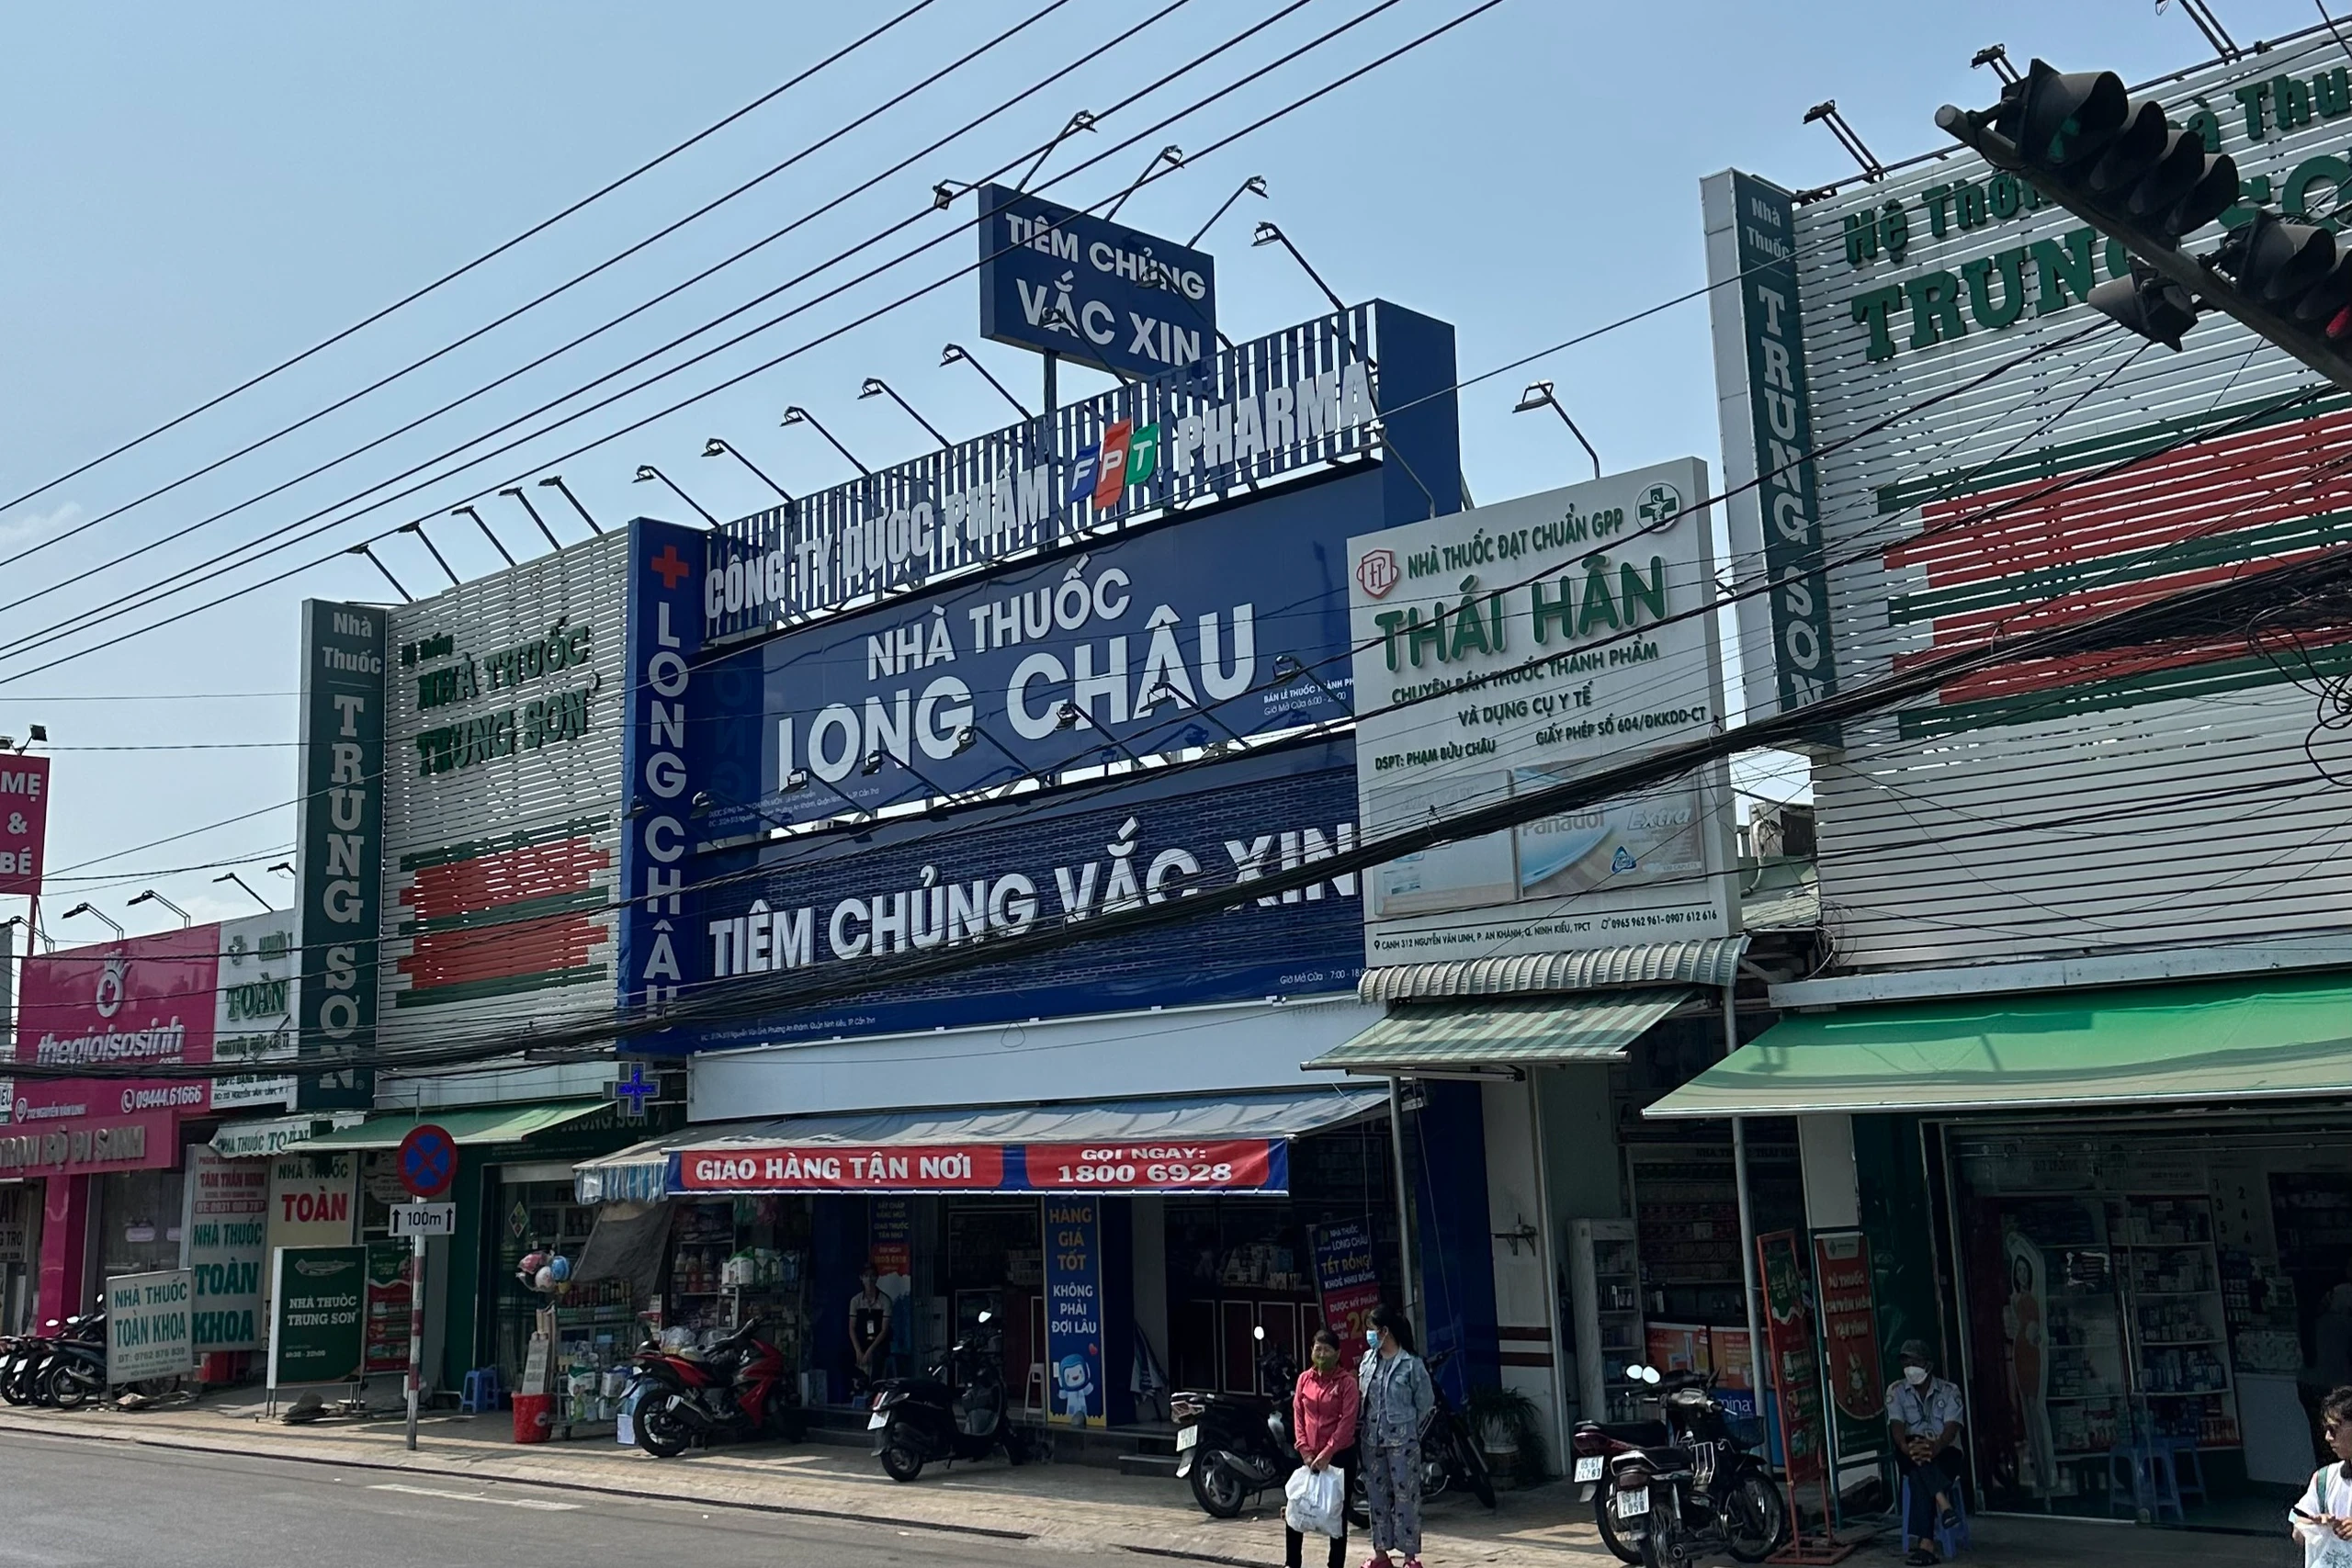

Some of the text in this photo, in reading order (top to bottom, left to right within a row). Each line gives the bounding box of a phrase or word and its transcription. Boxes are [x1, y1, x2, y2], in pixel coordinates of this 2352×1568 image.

[1751, 197, 1781, 229] Nhà
[1747, 225, 1791, 263] Thuốc
[1844, 197, 1908, 265] Hệ
[1005, 212, 1206, 300] TIÊM CHỦNG
[1850, 226, 2141, 364] TRUN
[1015, 269, 1201, 367] VẮC XIN
[1757, 283, 1808, 547] TRUNG
[705, 551, 786, 619] CÔNG
[795, 533, 834, 593] TY
[842, 502, 933, 581] DƯỢC
[945, 457, 1049, 549] PHẨM
[1178, 360, 1373, 477] PHARMA
[1408, 544, 1438, 580] NHÀ
[1443, 525, 1494, 571] THUỐC
[1498, 529, 1528, 560] ĐẠT
[1532, 504, 1588, 551] CHUẨN
[1591, 506, 1623, 539] GPP
[334, 611, 373, 637] Nhà
[866, 553, 1132, 681] NHÀ THUỐC
[1374, 574, 1507, 671] THÁI
[322, 646, 382, 675] Thuốc
[417, 615, 590, 711] NHÀ THUỐC
[1391, 677, 1451, 706] CHUYÊN
[1488, 656, 1545, 689] THUỐC
[1548, 646, 1605, 679] THÀNH
[1609, 635, 1659, 665] PHẨM
[647, 601, 689, 799] LONG
[777, 602, 1257, 794] LONG CHÂU
[1263, 692, 1279, 704] BÁN
[1290, 683, 1316, 697] THUỐC
[1307, 696, 1322, 705] 6:00
[1458, 681, 1594, 728] VÀ DỤNG CỤ Y TẾ
[415, 711, 514, 777] TRUNG
[1535, 723, 1563, 746] GIẤY
[1565, 717, 1595, 741] PHÉP
[1598, 713, 1614, 736] SỐ
[1374, 754, 1405, 771] DSPT:
[1407, 750, 1439, 770] PHẠM
[1465, 738, 1496, 755] CHÂU
[1, 772, 41, 802] MẸ
[7, 811, 28, 835] &
[322, 694, 366, 924] TRUNG
[0, 847, 32, 875] BÉ
[708, 816, 1359, 978] TIÊM CHỦNG VẮC XIN
[1382, 942, 1400, 951] CẠNH
[1401, 940, 1413, 948] 312
[1414, 932, 1442, 947] NGUYỄN
[1442, 934, 1456, 944] VĂN
[1458, 933, 1476, 943] LINH,
[1485, 931, 1496, 940] AN
[1534, 925, 1553, 935] NINH
[1574, 921, 1591, 932] TPCT
[1611, 918, 1630, 929] 0965
[1632, 917, 1645, 927] 962
[1687, 911, 1701, 922] 612
[1702, 910, 1717, 920] 616
[1280, 970, 1345, 984] Giờ Mở Cửa 7:00
[225, 972, 291, 1021] TOÀN
[277, 1161, 304, 1180] NHÀ
[695, 1152, 971, 1186] GIAO HÀNG TẬN NƠI
[1080, 1145, 1207, 1165] GỌI NGAY:
[1057, 1163, 1234, 1183] 1800 6928
[281, 1185, 348, 1223] TOÀN
[407, 1211, 442, 1226] 100m
[1049, 1206, 1091, 1224] HÀNG
[224, 1215, 263, 1247] THUỐC
[1057, 1226, 1085, 1247] GIÁ
[1332, 1238, 1351, 1251] LONG
[194, 1257, 259, 1296] TOÀN
[1057, 1249, 1087, 1271] TỐT
[115, 1276, 187, 1309] NHÀ THUỐC
[288, 1295, 315, 1310] NHÀ
[1053, 1284, 1093, 1297] KHÔNG
[1059, 1298, 1088, 1315] PHẢI
[115, 1309, 187, 1348] TOÀN KHOA
[192, 1309, 254, 1346] KHOA
[288, 1314, 328, 1326] TRUNG
[1051, 1318, 1097, 1337] ĐỢI LÂU
